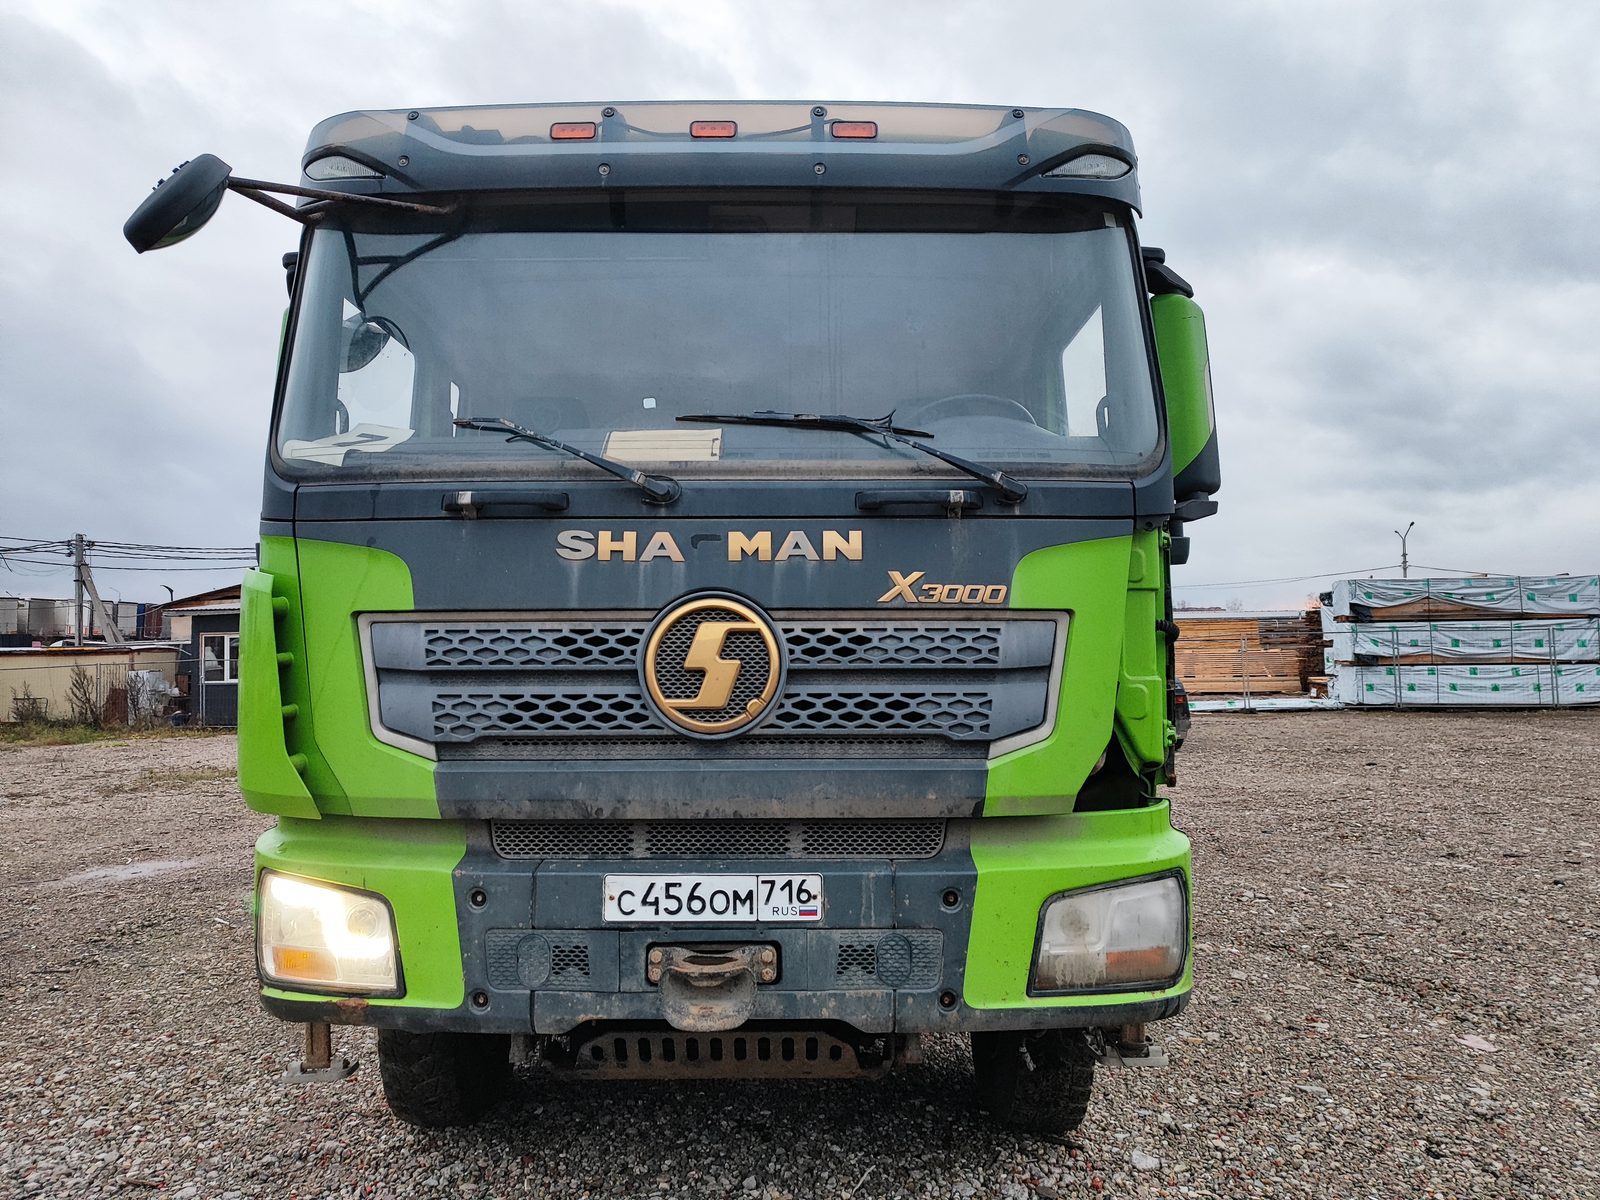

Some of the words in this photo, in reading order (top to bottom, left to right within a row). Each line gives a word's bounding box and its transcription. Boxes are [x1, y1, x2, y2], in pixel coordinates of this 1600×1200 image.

[877, 570, 1008, 604] X3000
[761, 879, 812, 905] 716
[772, 906, 798, 916] RUS
